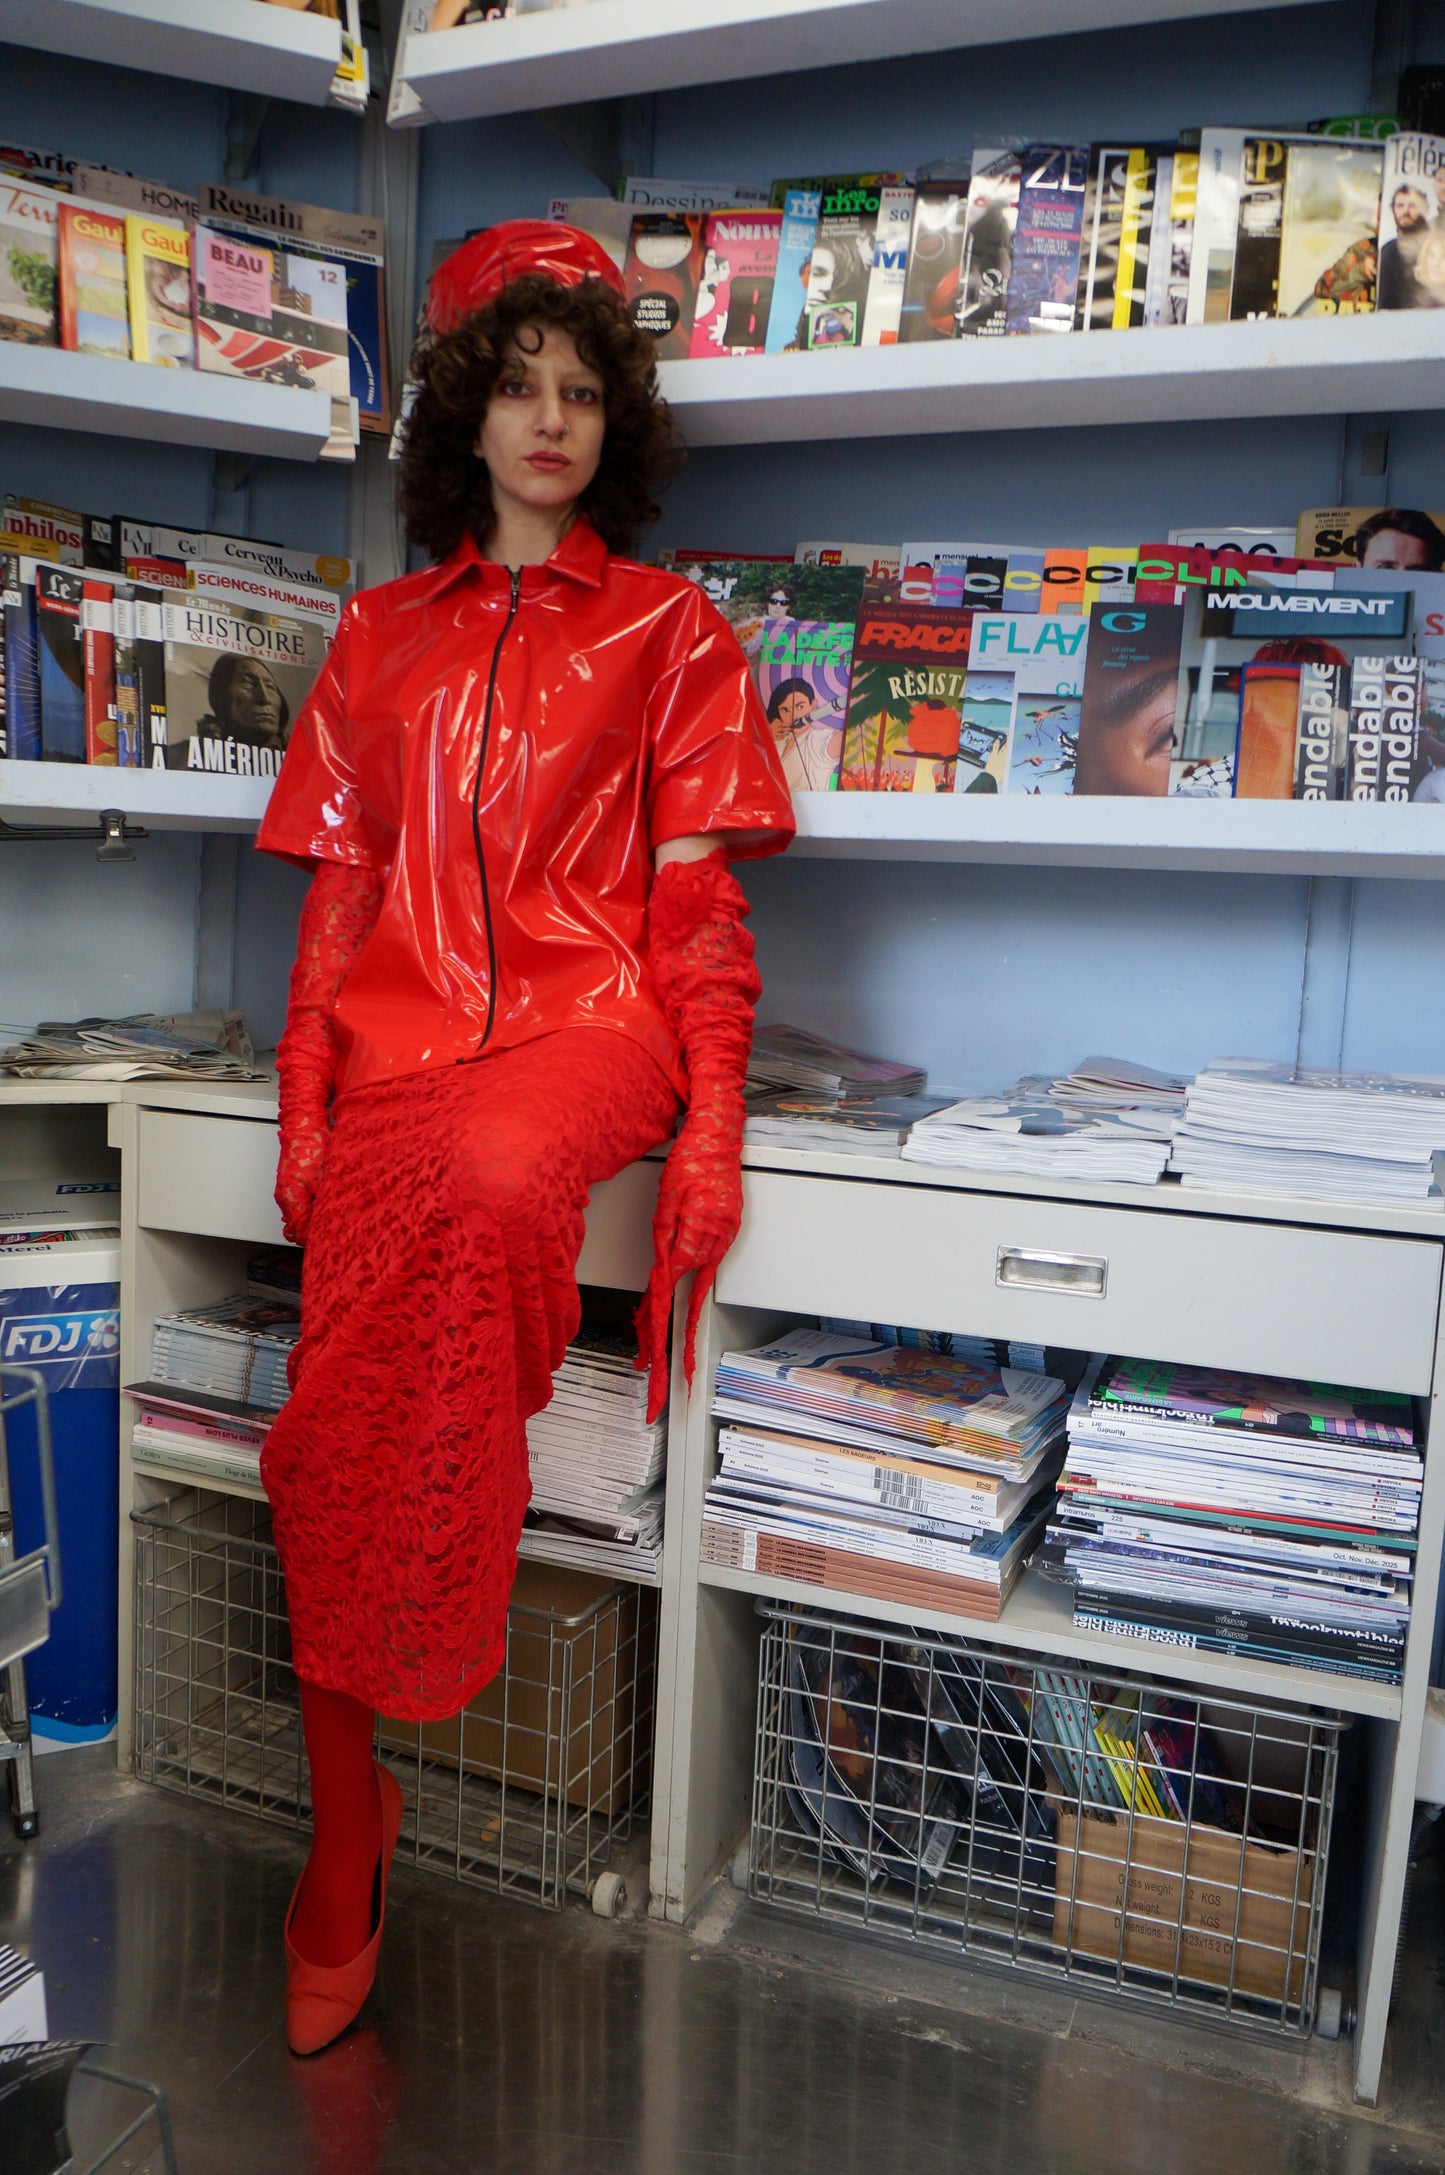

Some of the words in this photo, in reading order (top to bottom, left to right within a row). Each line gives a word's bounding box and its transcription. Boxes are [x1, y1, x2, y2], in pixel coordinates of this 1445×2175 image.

[142, 187, 200, 220] HOME
[207, 187, 305, 233] Regain
[210, 244, 263, 274] BEAU
[318, 269, 339, 285] 12
[224, 543, 284, 565] Cerveau
[1207, 592, 1395, 616] MOUVEMENT
[186, 611, 307, 656] HISTOIRE
[1100, 612, 1147, 634] G
[206, 635, 307, 665] CIVILISATIONS
[61, 1184, 105, 1194] FDJ
[5, 1320, 82, 1357] FDJ
[159, 1312, 303, 1346] vendable
[1096, 1426, 1126, 1437] Numéro
[850, 1451, 876, 1462] NAGEURS
[970, 1504, 984, 1513] AOC
[971, 1493, 985, 1502] AOC
[977, 1519, 991, 1527] AOC
[1111, 1514, 1124, 1523] 225
[1333, 1552, 1347, 1561] Oct.
[1349, 1555, 1364, 1564] Nov.
[1365, 1555, 1381, 1568] Déc.
[1382, 1560, 1398, 1570] 2025
[1118, 1873, 1142, 1889] Goss
[1144, 1881, 1174, 1897] weight:
[1201, 1892, 1222, 1907] KGS
[1115, 1895, 1130, 1909] Nt
[1132, 1900, 1161, 1916] weight:
[1200, 1914, 1221, 1930] KGS
[1114, 1917, 1164, 1940] Dmensions:
